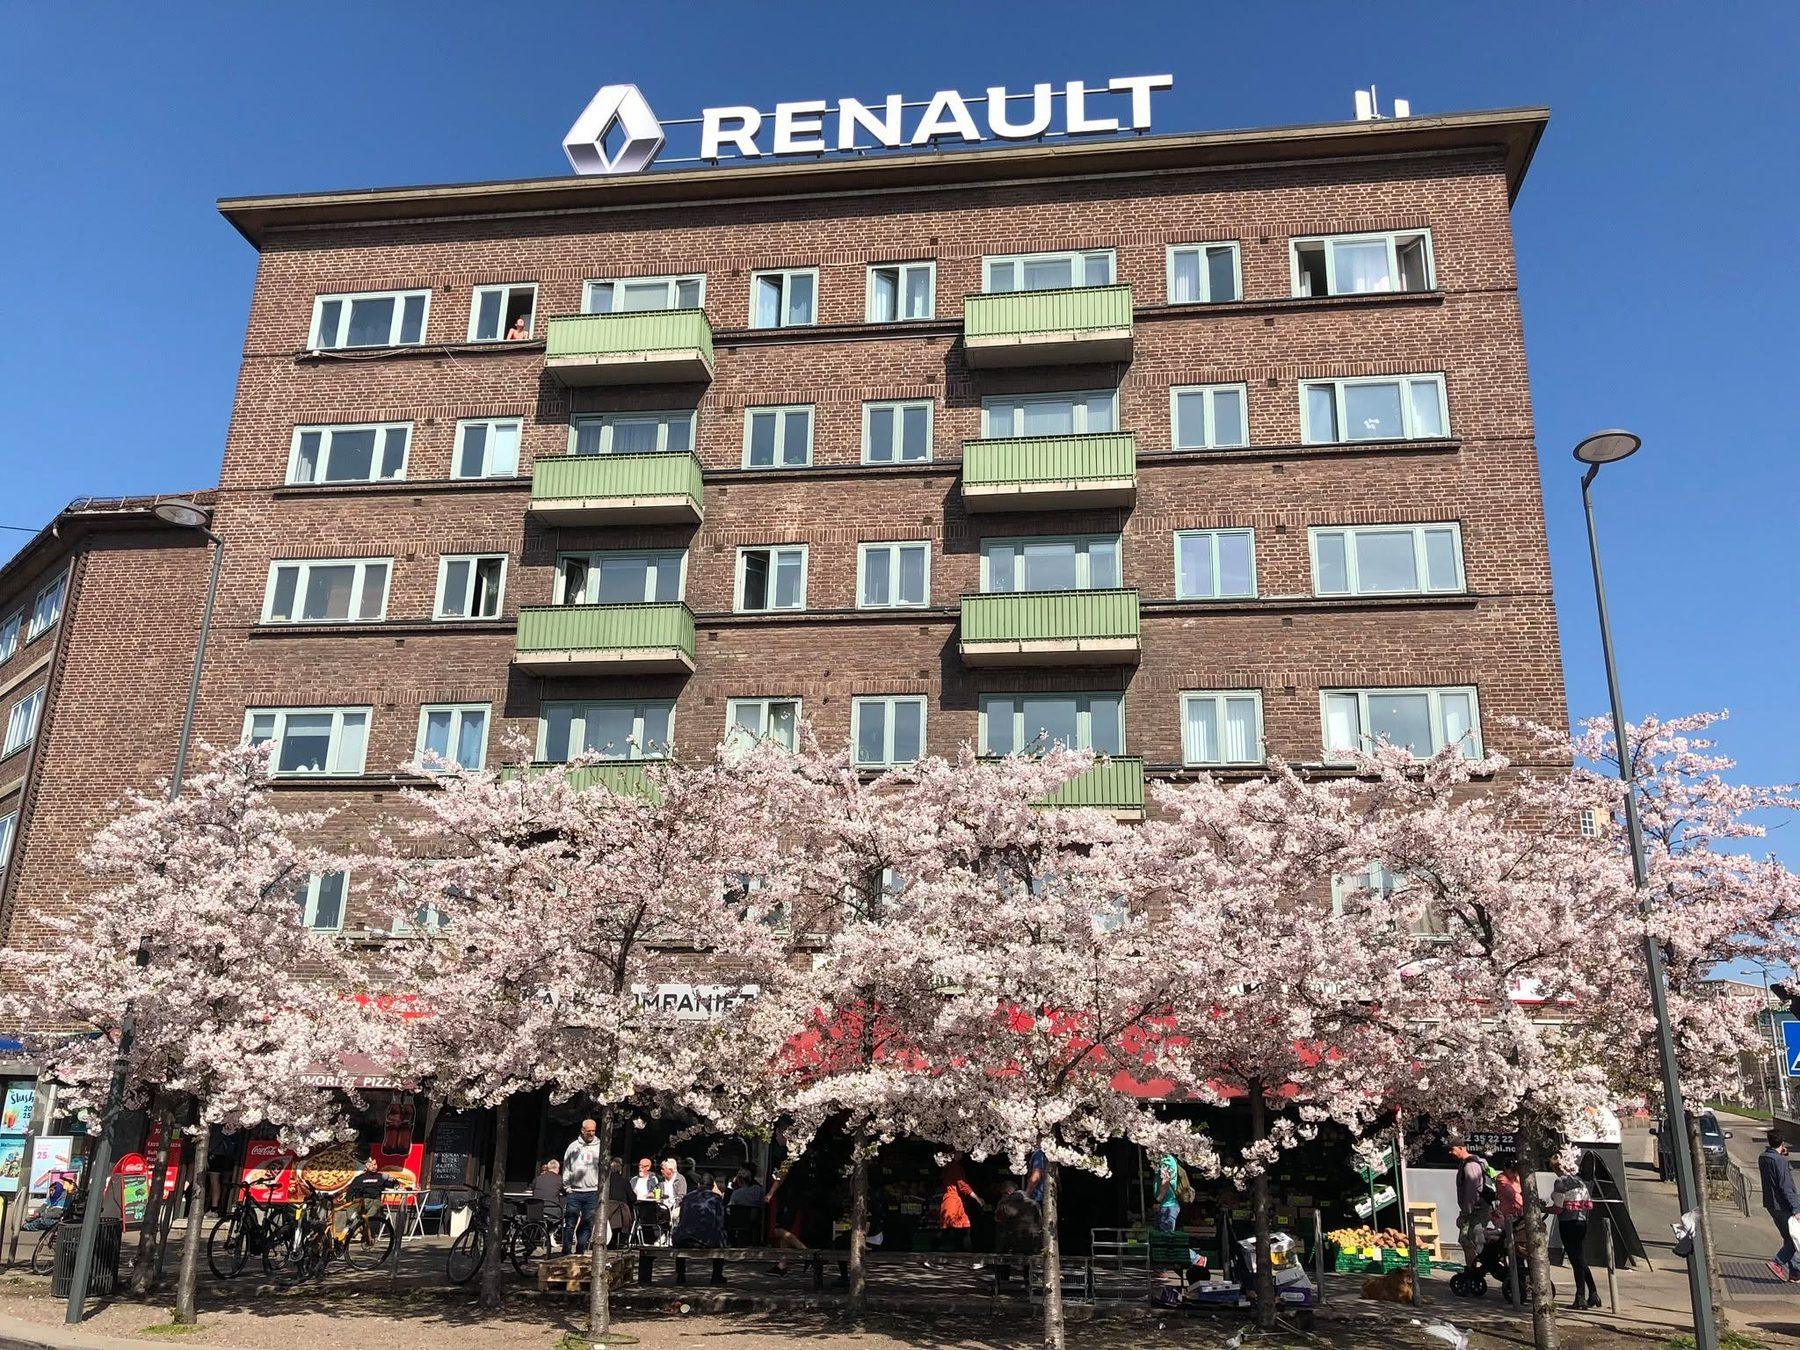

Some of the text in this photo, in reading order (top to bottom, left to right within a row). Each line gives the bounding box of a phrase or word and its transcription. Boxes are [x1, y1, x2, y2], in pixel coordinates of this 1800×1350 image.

[701, 73, 1174, 161] RENAULT
[362, 1076, 403, 1088] PIZZA
[1501, 1135, 1514, 1143] 22
